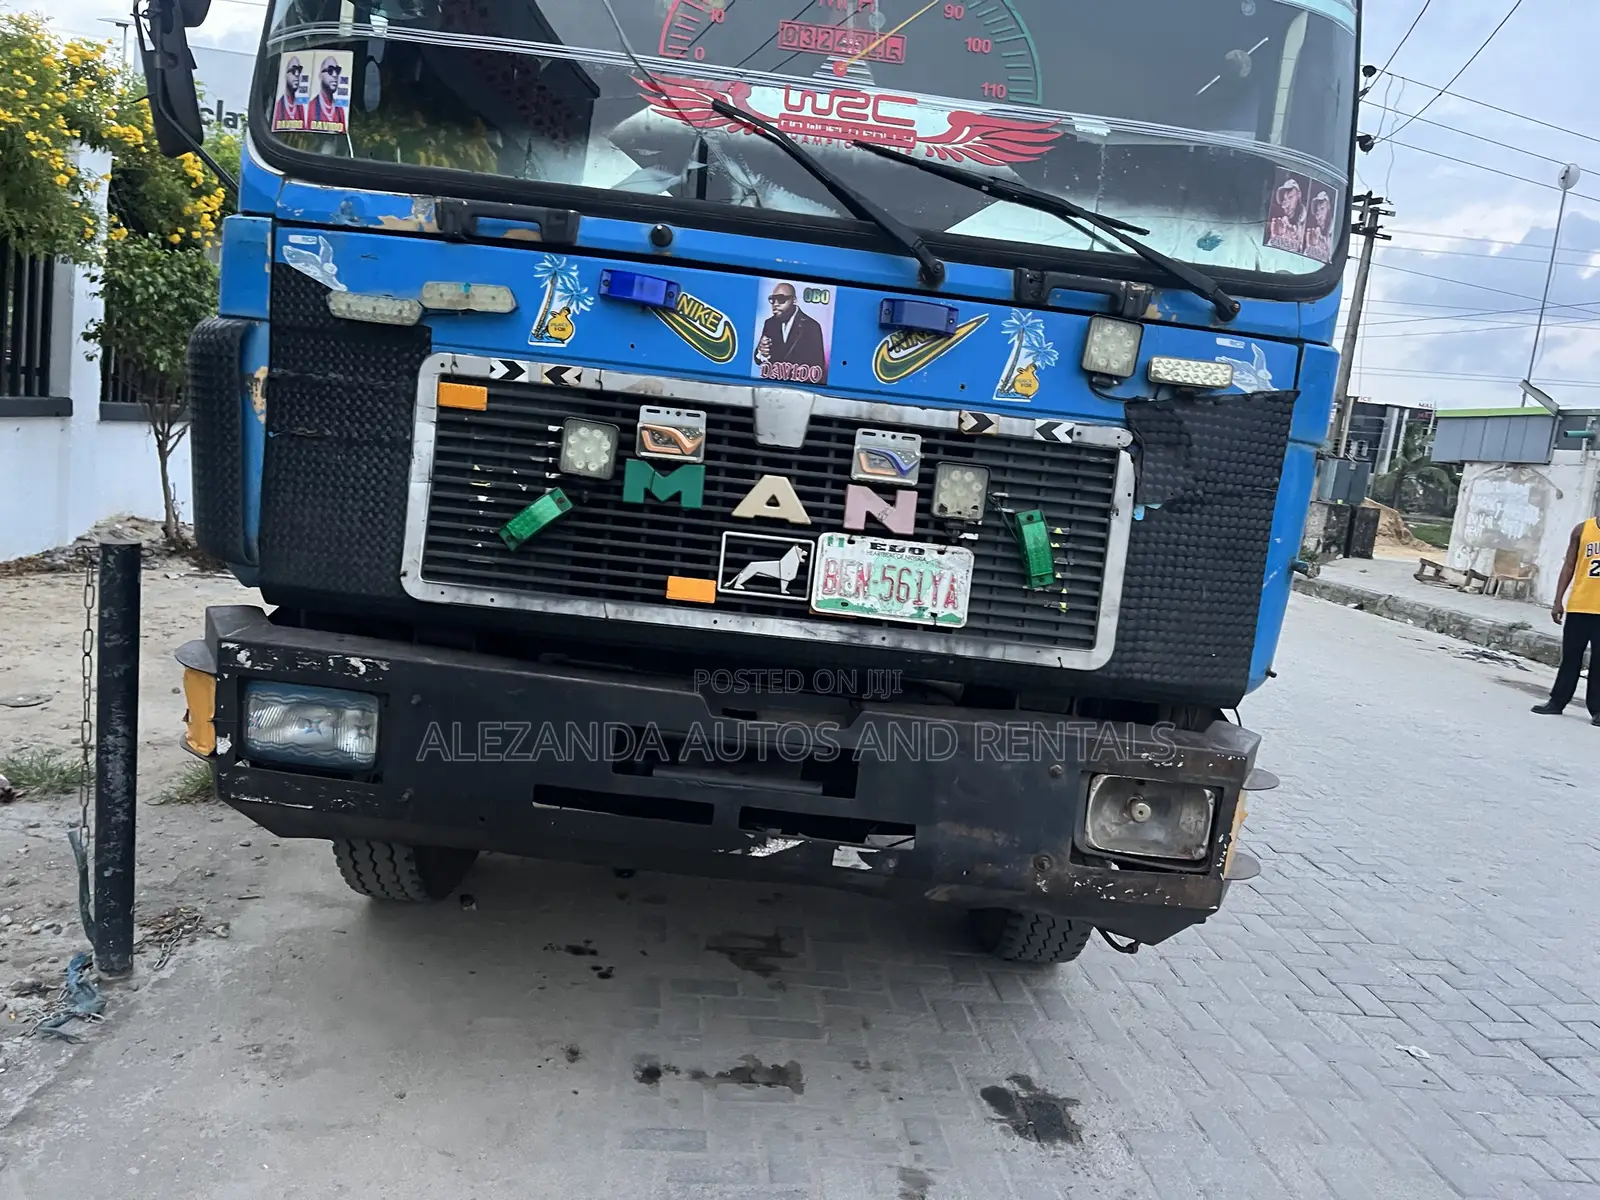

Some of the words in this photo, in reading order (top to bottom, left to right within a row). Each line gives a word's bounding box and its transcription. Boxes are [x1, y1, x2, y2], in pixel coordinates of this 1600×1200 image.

[710, 8, 726, 24] 10
[944, 4, 964, 20] 90
[694, 46, 706, 61] 0
[964, 36, 992, 54] 100
[980, 82, 1007, 99] 110
[676, 293, 723, 333] NIKE
[622, 458, 920, 535] MAN
